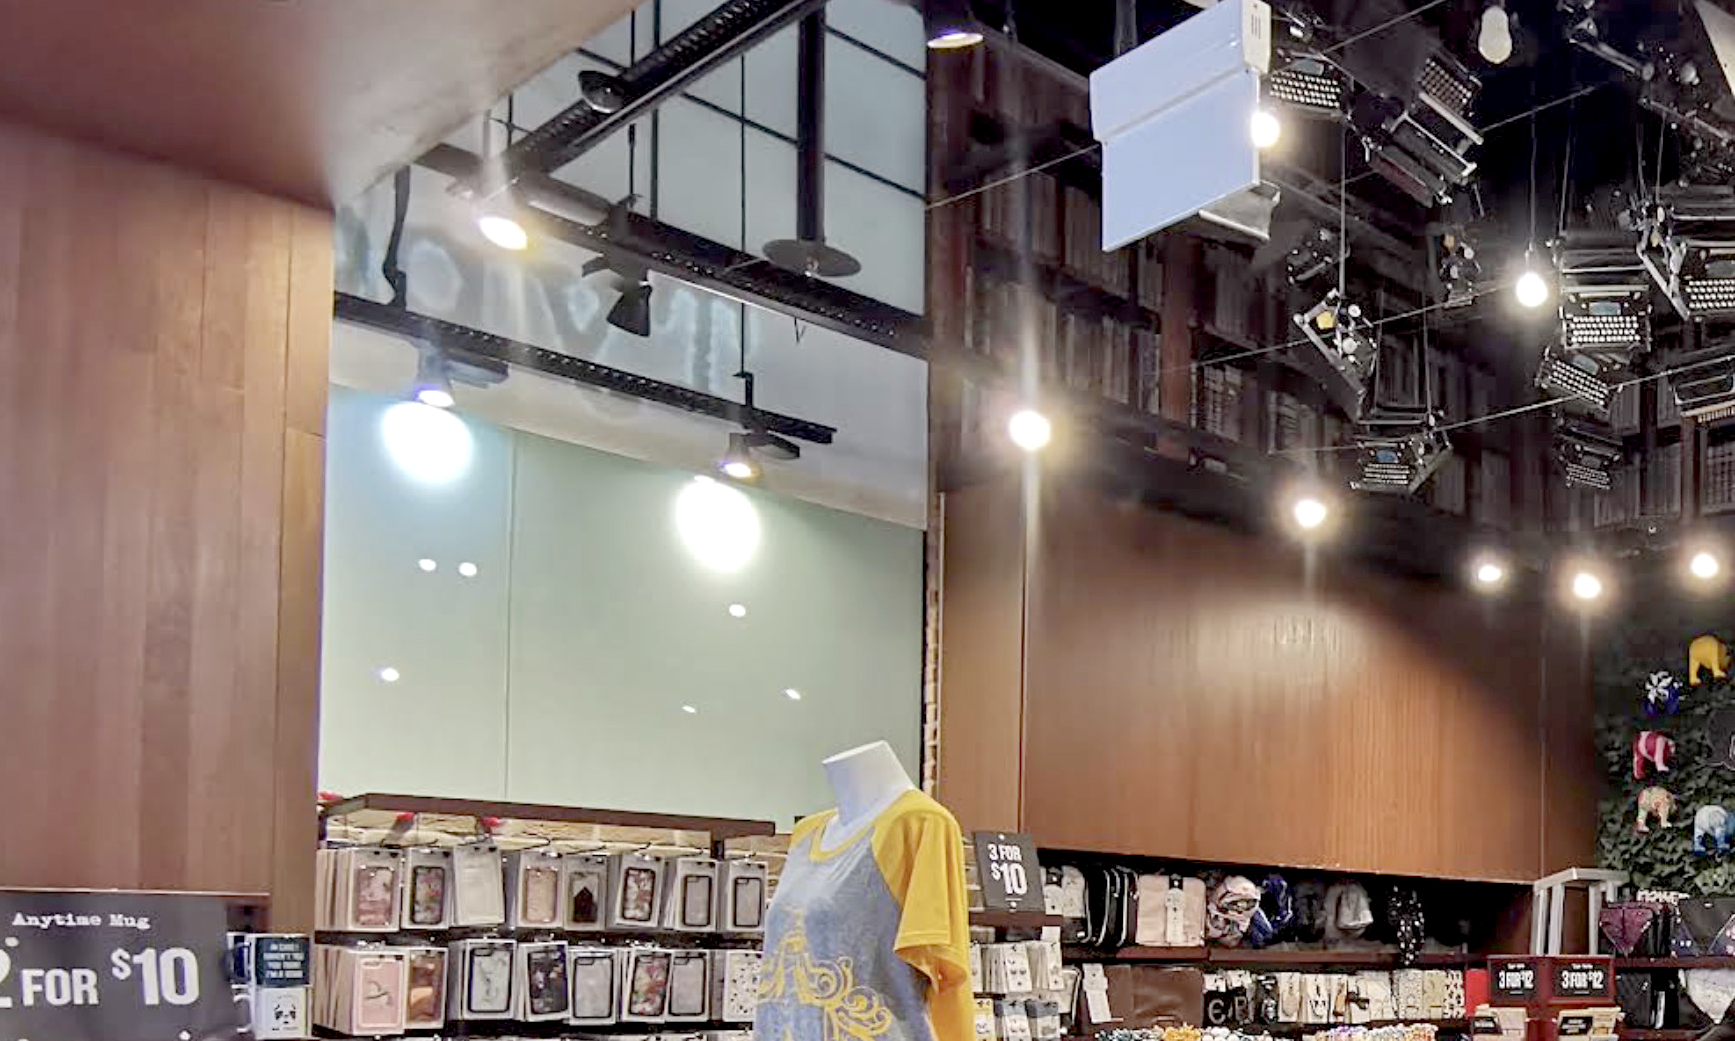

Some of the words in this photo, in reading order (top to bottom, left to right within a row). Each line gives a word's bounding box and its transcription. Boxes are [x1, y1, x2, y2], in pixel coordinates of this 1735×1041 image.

[987, 843, 999, 861] 3
[998, 844, 1022, 861] FOR
[990, 861, 1028, 895] $10
[12, 912, 101, 930] Anytime
[109, 913, 151, 930] Mug
[21, 967, 100, 1007] FOR
[110, 946, 200, 1006] $10
[1498, 970, 1506, 989] 3
[1505, 970, 1521, 989] FOR
[1561, 970, 1570, 989] 3
[1569, 970, 1588, 989] FOR
